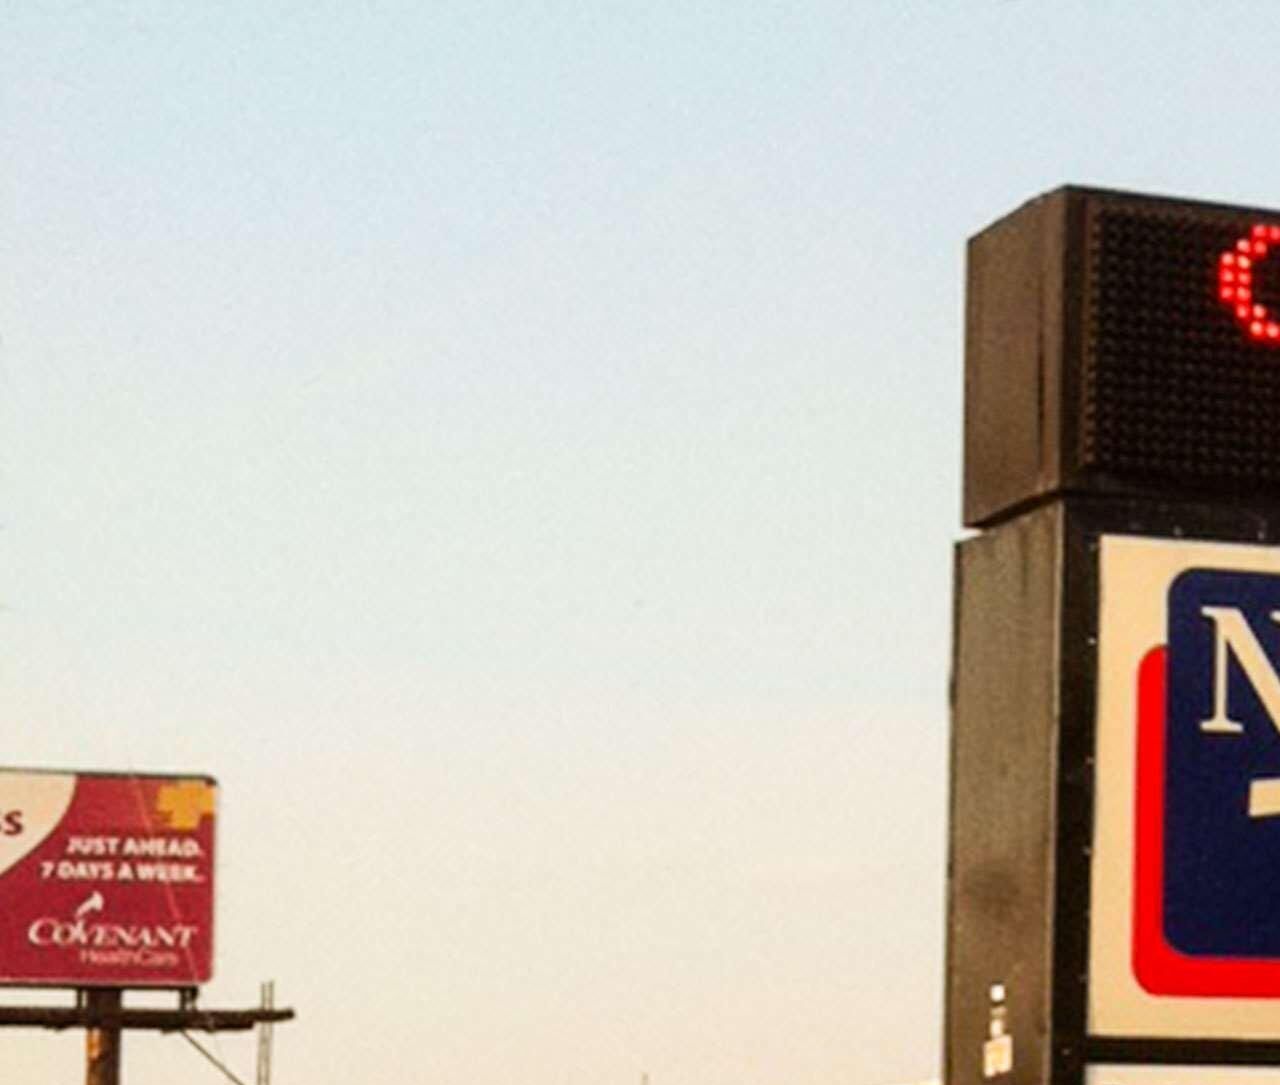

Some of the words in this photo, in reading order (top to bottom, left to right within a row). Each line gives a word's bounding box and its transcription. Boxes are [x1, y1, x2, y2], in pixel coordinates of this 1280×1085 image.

[67, 836, 120, 856] JUST
[40, 861, 54, 879] 7
[57, 861, 114, 880] DAYS
[117, 862, 134, 881] A
[28, 916, 198, 948] COVENANT
